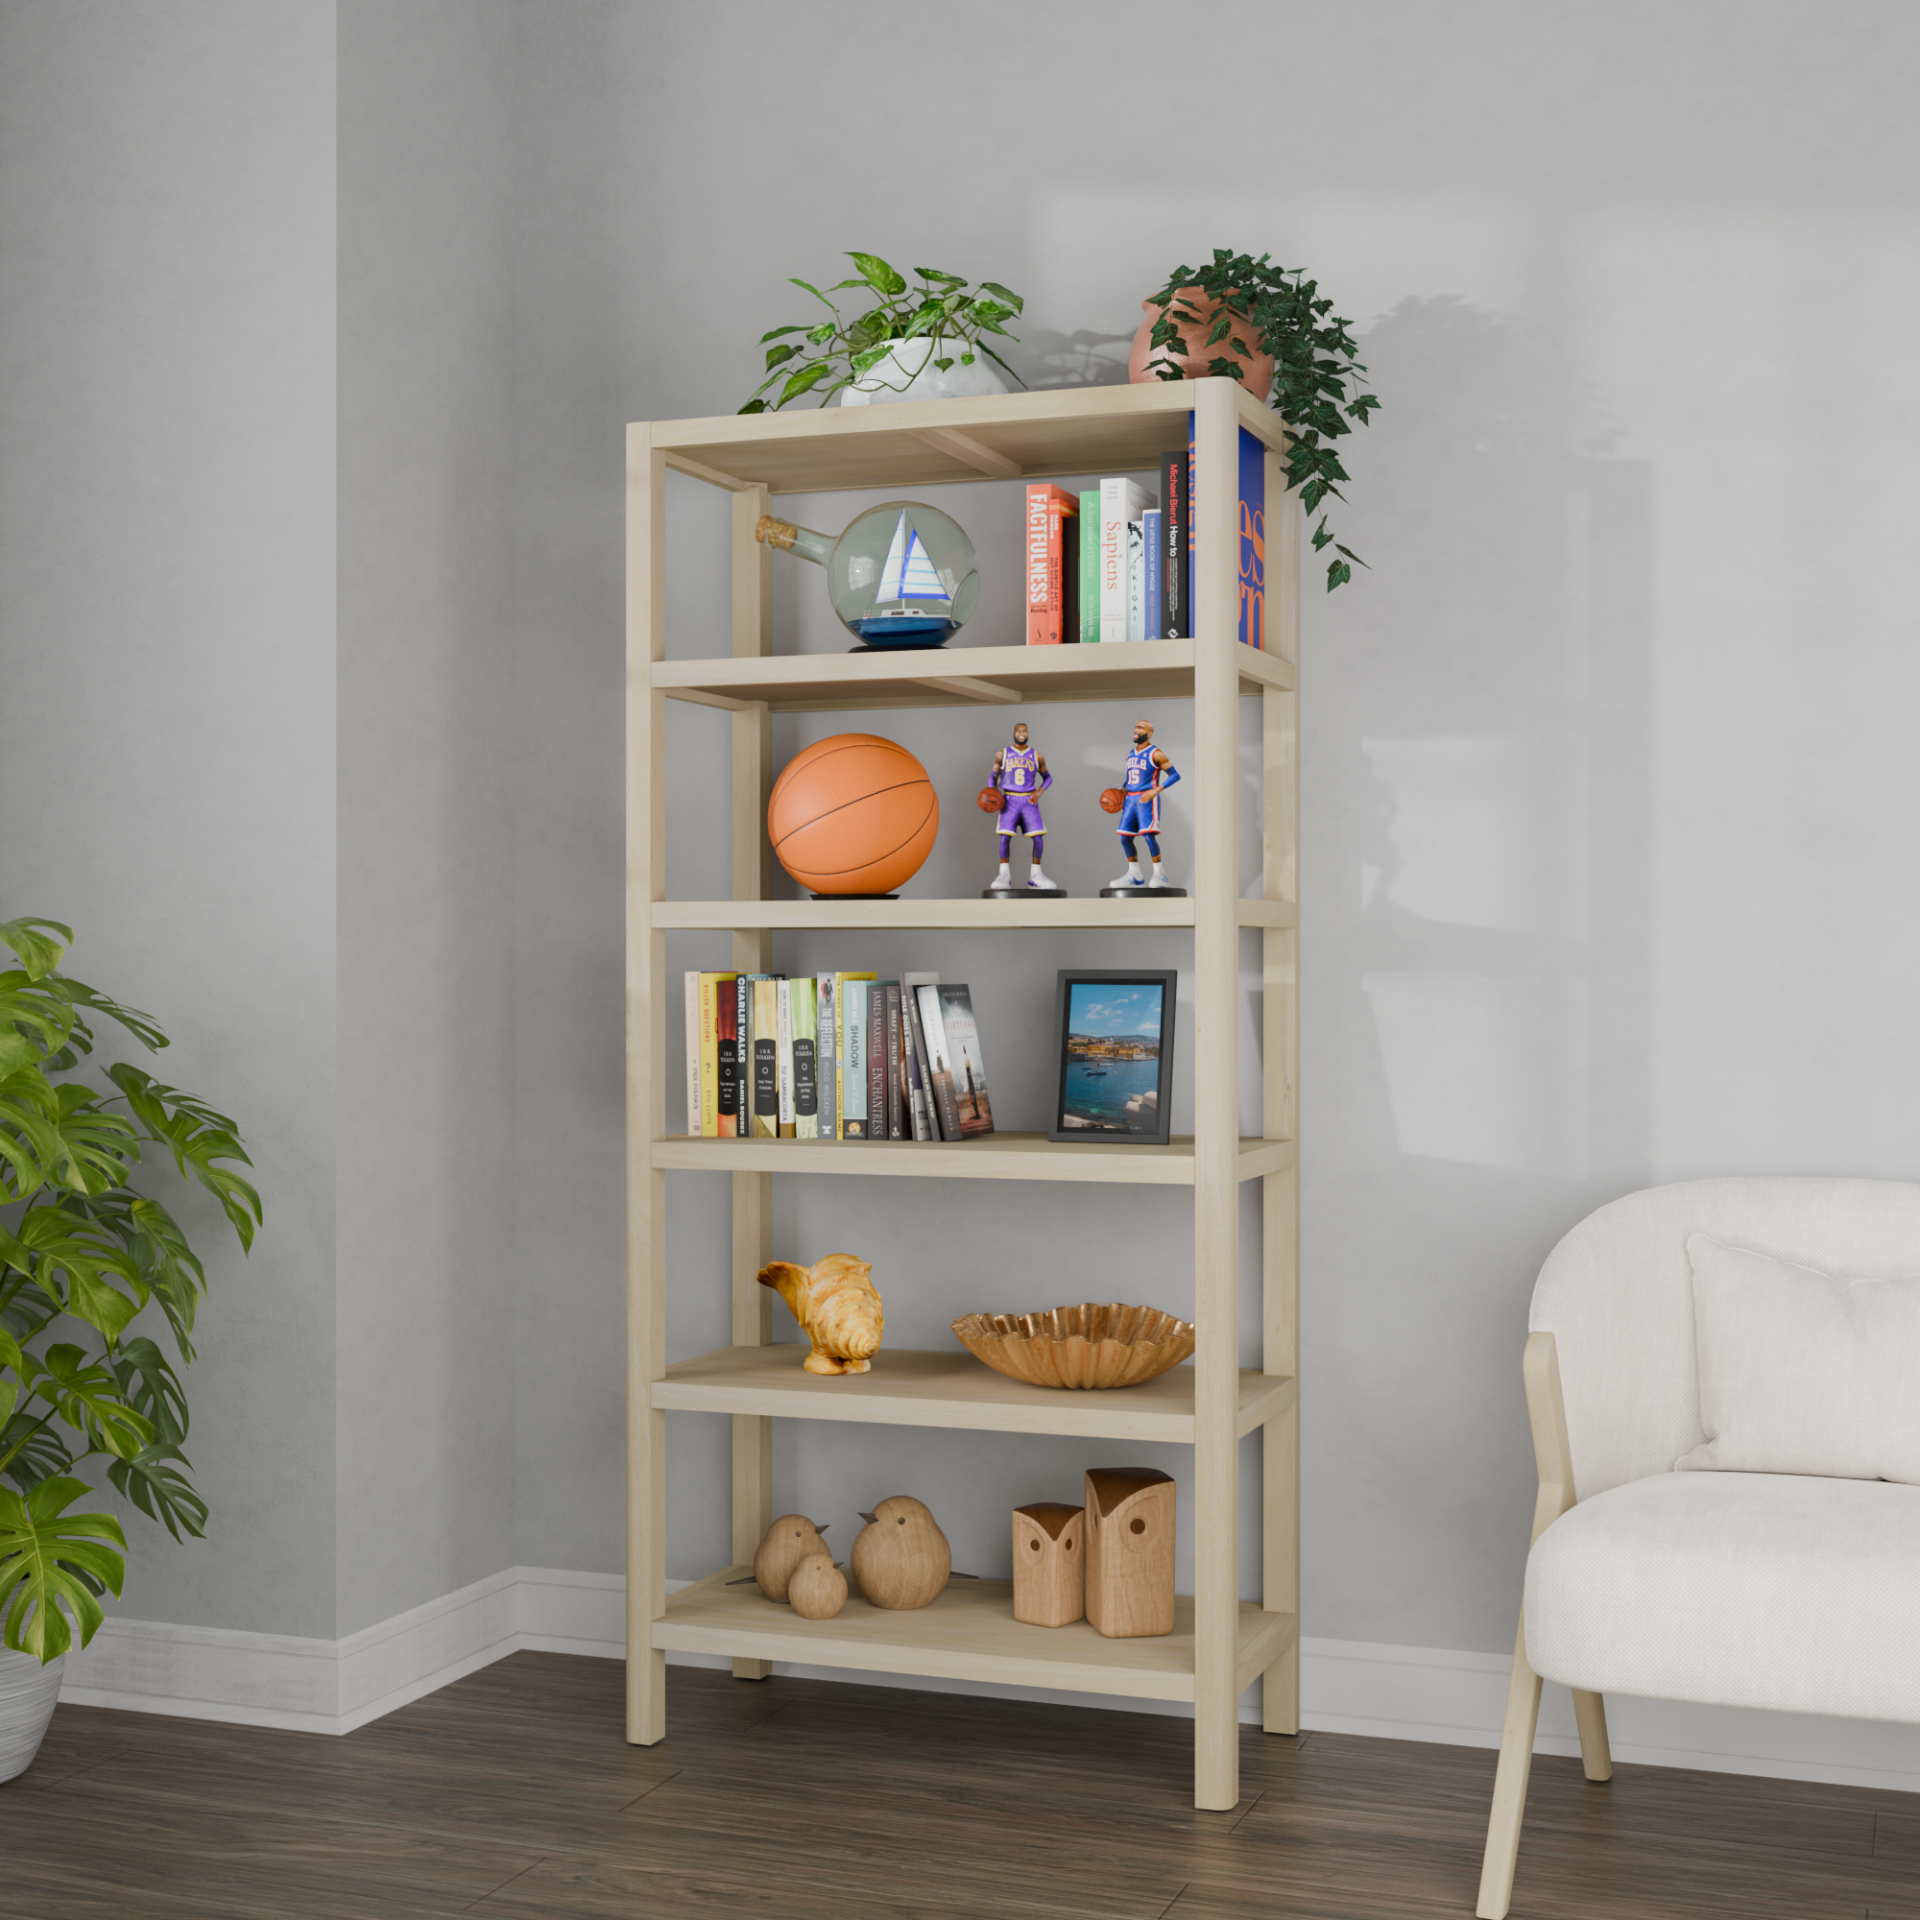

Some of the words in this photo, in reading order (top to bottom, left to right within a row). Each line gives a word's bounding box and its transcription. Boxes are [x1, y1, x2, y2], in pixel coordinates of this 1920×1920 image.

[1169, 464, 1178, 498] Michael
[1169, 499, 1178, 525] Bierut
[1030, 494, 1048, 603] FACTFULNESS
[1169, 526, 1178, 545] How
[1102, 521, 1121, 590] Sapiens
[1170, 547, 1178, 557] to
[1005, 757, 1035, 772] LAKERS
[1015, 768, 1025, 785] 6
[1128, 769, 1140, 785] 15
[822, 1008, 831, 1018] THE
[873, 991, 881, 1016] JAMES
[820, 1019, 833, 1057] REFLECTION
[850, 1025, 859, 1068] SHADOW
[873, 1018, 882, 1057] MAXWELL
[872, 1068, 883, 1135] ENCHANTRESS
